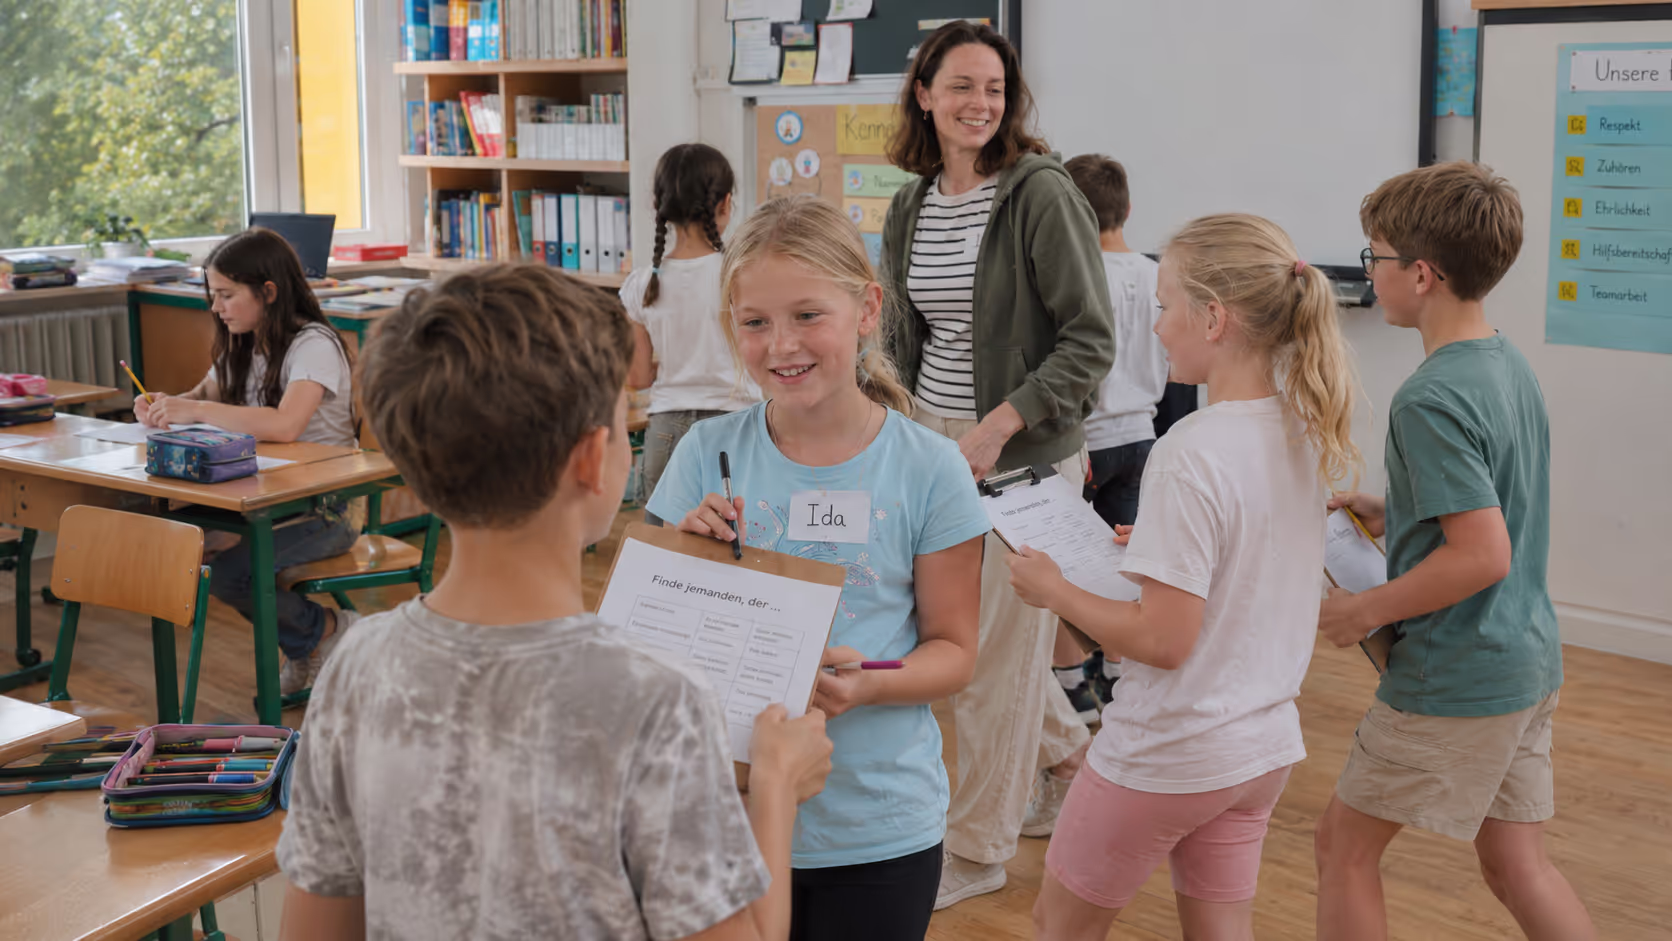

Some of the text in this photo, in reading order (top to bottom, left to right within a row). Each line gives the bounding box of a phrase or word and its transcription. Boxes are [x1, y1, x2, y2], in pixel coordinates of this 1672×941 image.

[1595, 58, 1660, 81] Unsere
[1600, 117, 1641, 134] Respekt
[1597, 159, 1641, 174] Zuhören
[1595, 200, 1651, 217] Ehrlichkeit
[1589, 285, 1648, 303] Teamarbeit
[807, 503, 846, 527] Ida
[651, 574, 683, 590] Finde
[684, 583, 744, 606] jemanden,
[747, 598, 769, 609] der
